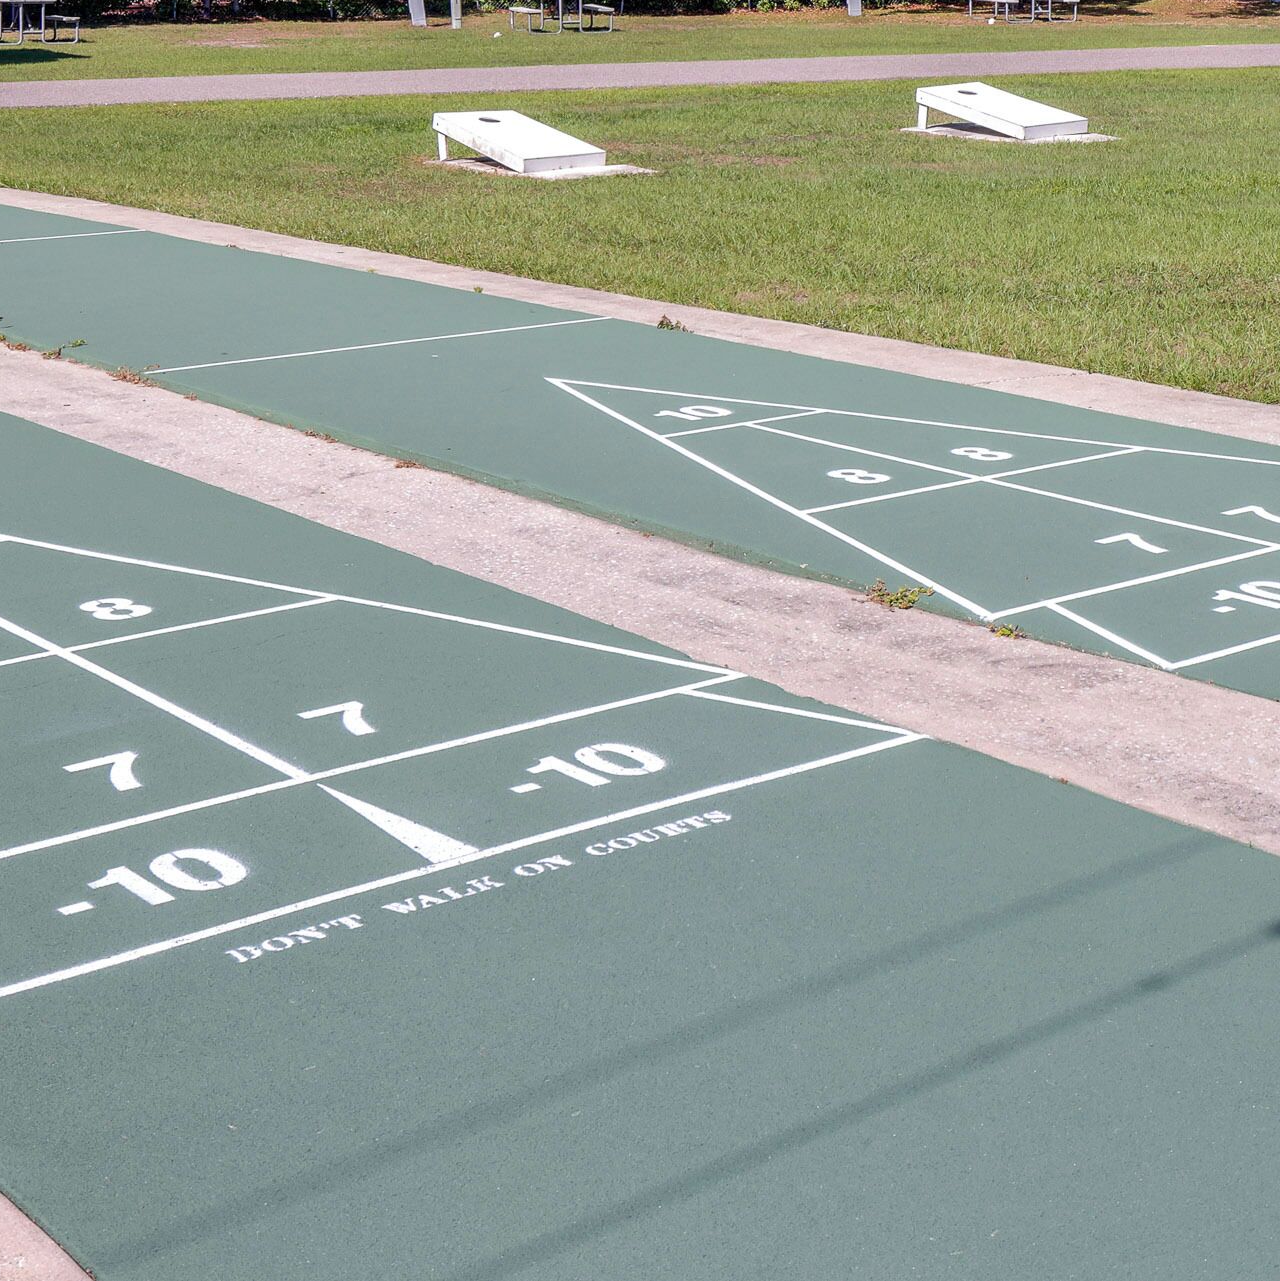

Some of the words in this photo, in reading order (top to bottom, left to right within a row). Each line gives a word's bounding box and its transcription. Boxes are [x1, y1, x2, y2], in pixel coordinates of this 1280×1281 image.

[653, 405, 734, 421] 10
[950, 446, 1014, 462] 8
[826, 468, 892, 485] 8
[1093, 532, 1169, 554] 7
[78, 597, 153, 621] 8
[296, 700, 377, 737] 7
[62, 750, 144, 793] 7
[509, 740, 669, 795] -10
[56, 846, 250, 917] -10
[224, 912, 365, 963] DON'T
[381, 874, 505, 915] WALK
[513, 853, 574, 878] ON
[584, 809, 734, 857] COURTS
